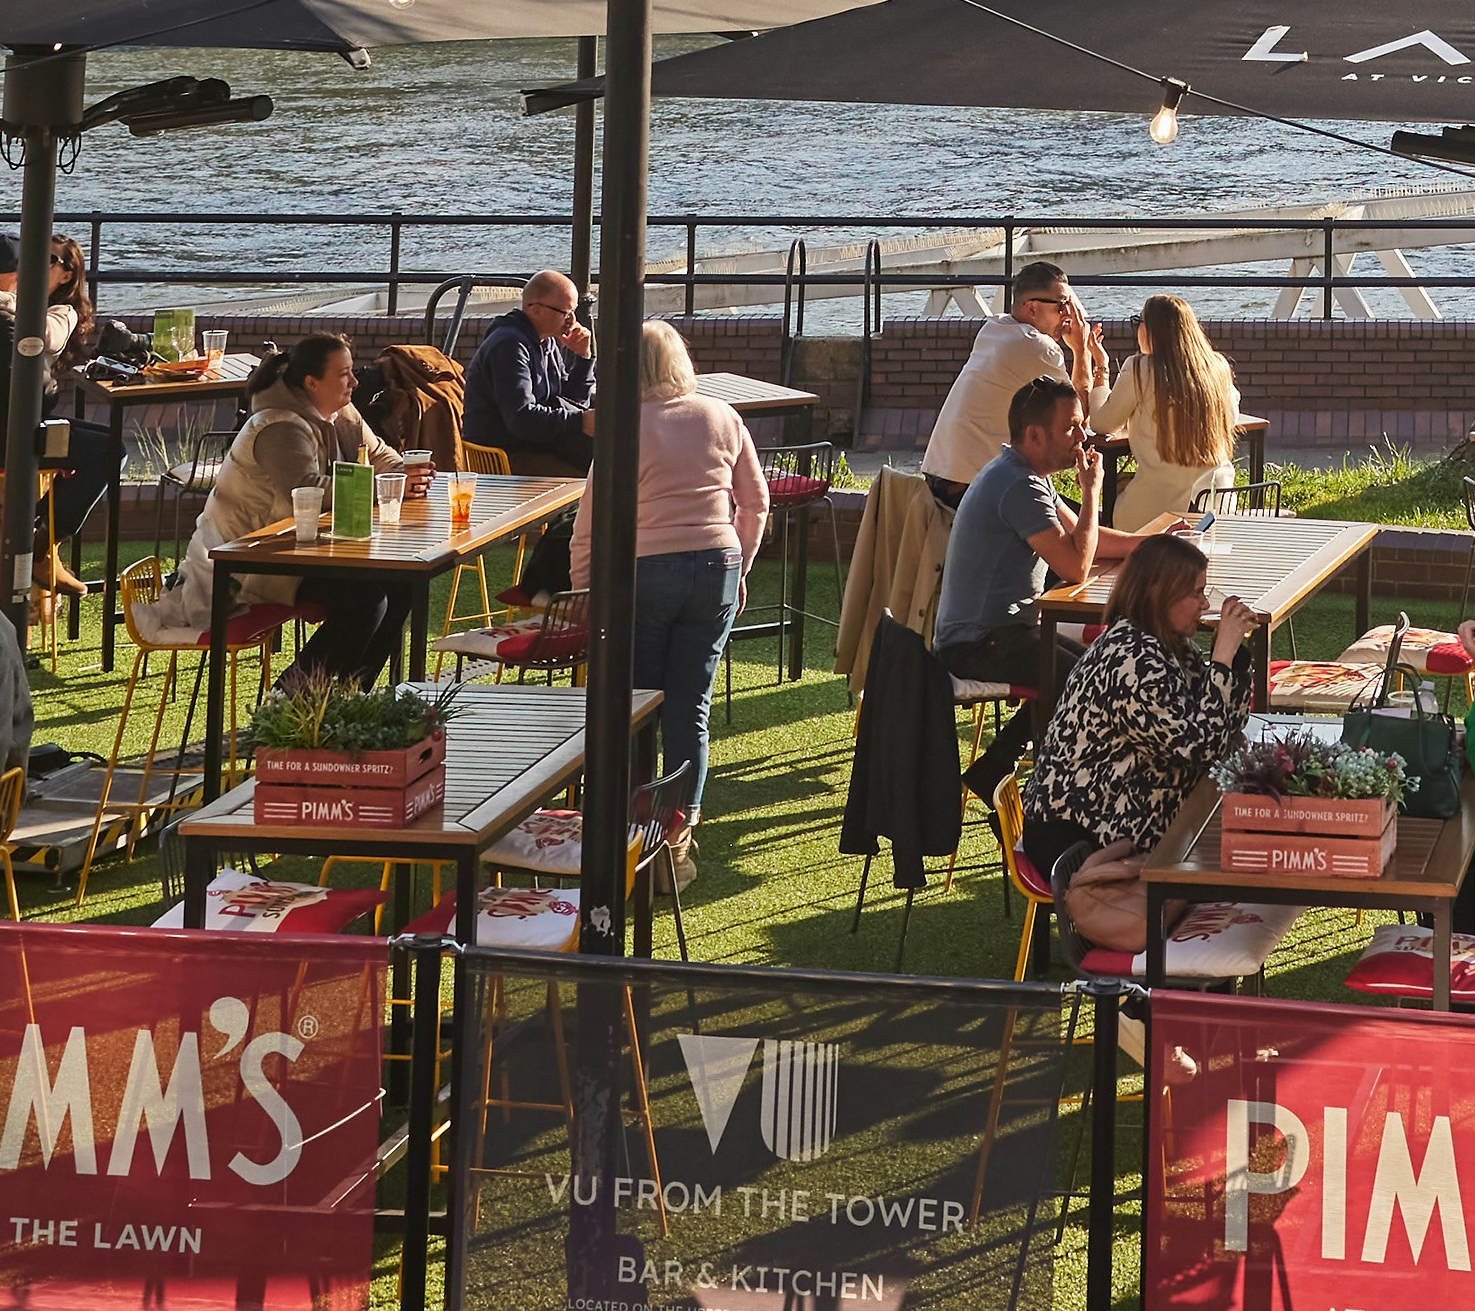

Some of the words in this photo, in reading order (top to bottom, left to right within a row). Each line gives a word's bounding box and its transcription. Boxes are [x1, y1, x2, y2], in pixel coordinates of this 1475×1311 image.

[1341, 73, 1386, 82] AT
[266, 760, 285, 771] TIME
[287, 760, 302, 772] FOR
[303, 761, 311, 772] A
[312, 762, 362, 774] SUNDOWNER
[363, 763, 394, 775] SPRITZ?
[301, 798, 355, 822] PIMM'S
[1234, 806, 1253, 818] TIME
[1255, 807, 1271, 819] FOR
[1273, 808, 1281, 819] A
[1335, 810, 1370, 823] SPRITZ?
[1271, 847, 1328, 871] PIMM'S
[543, 1173, 598, 1206] VU
[613, 1177, 723, 1216] FROM
[737, 1186, 812, 1225] THE
[827, 1193, 966, 1234] TOWER
[9, 1217, 78, 1248] THE
[94, 1222, 203, 1255] LAWN
[617, 1255, 684, 1286] BAR
[696, 1263, 719, 1290] &
[731, 1264, 885, 1301] KITCHEN
[568, 1298, 628, 1311] LOCATED
